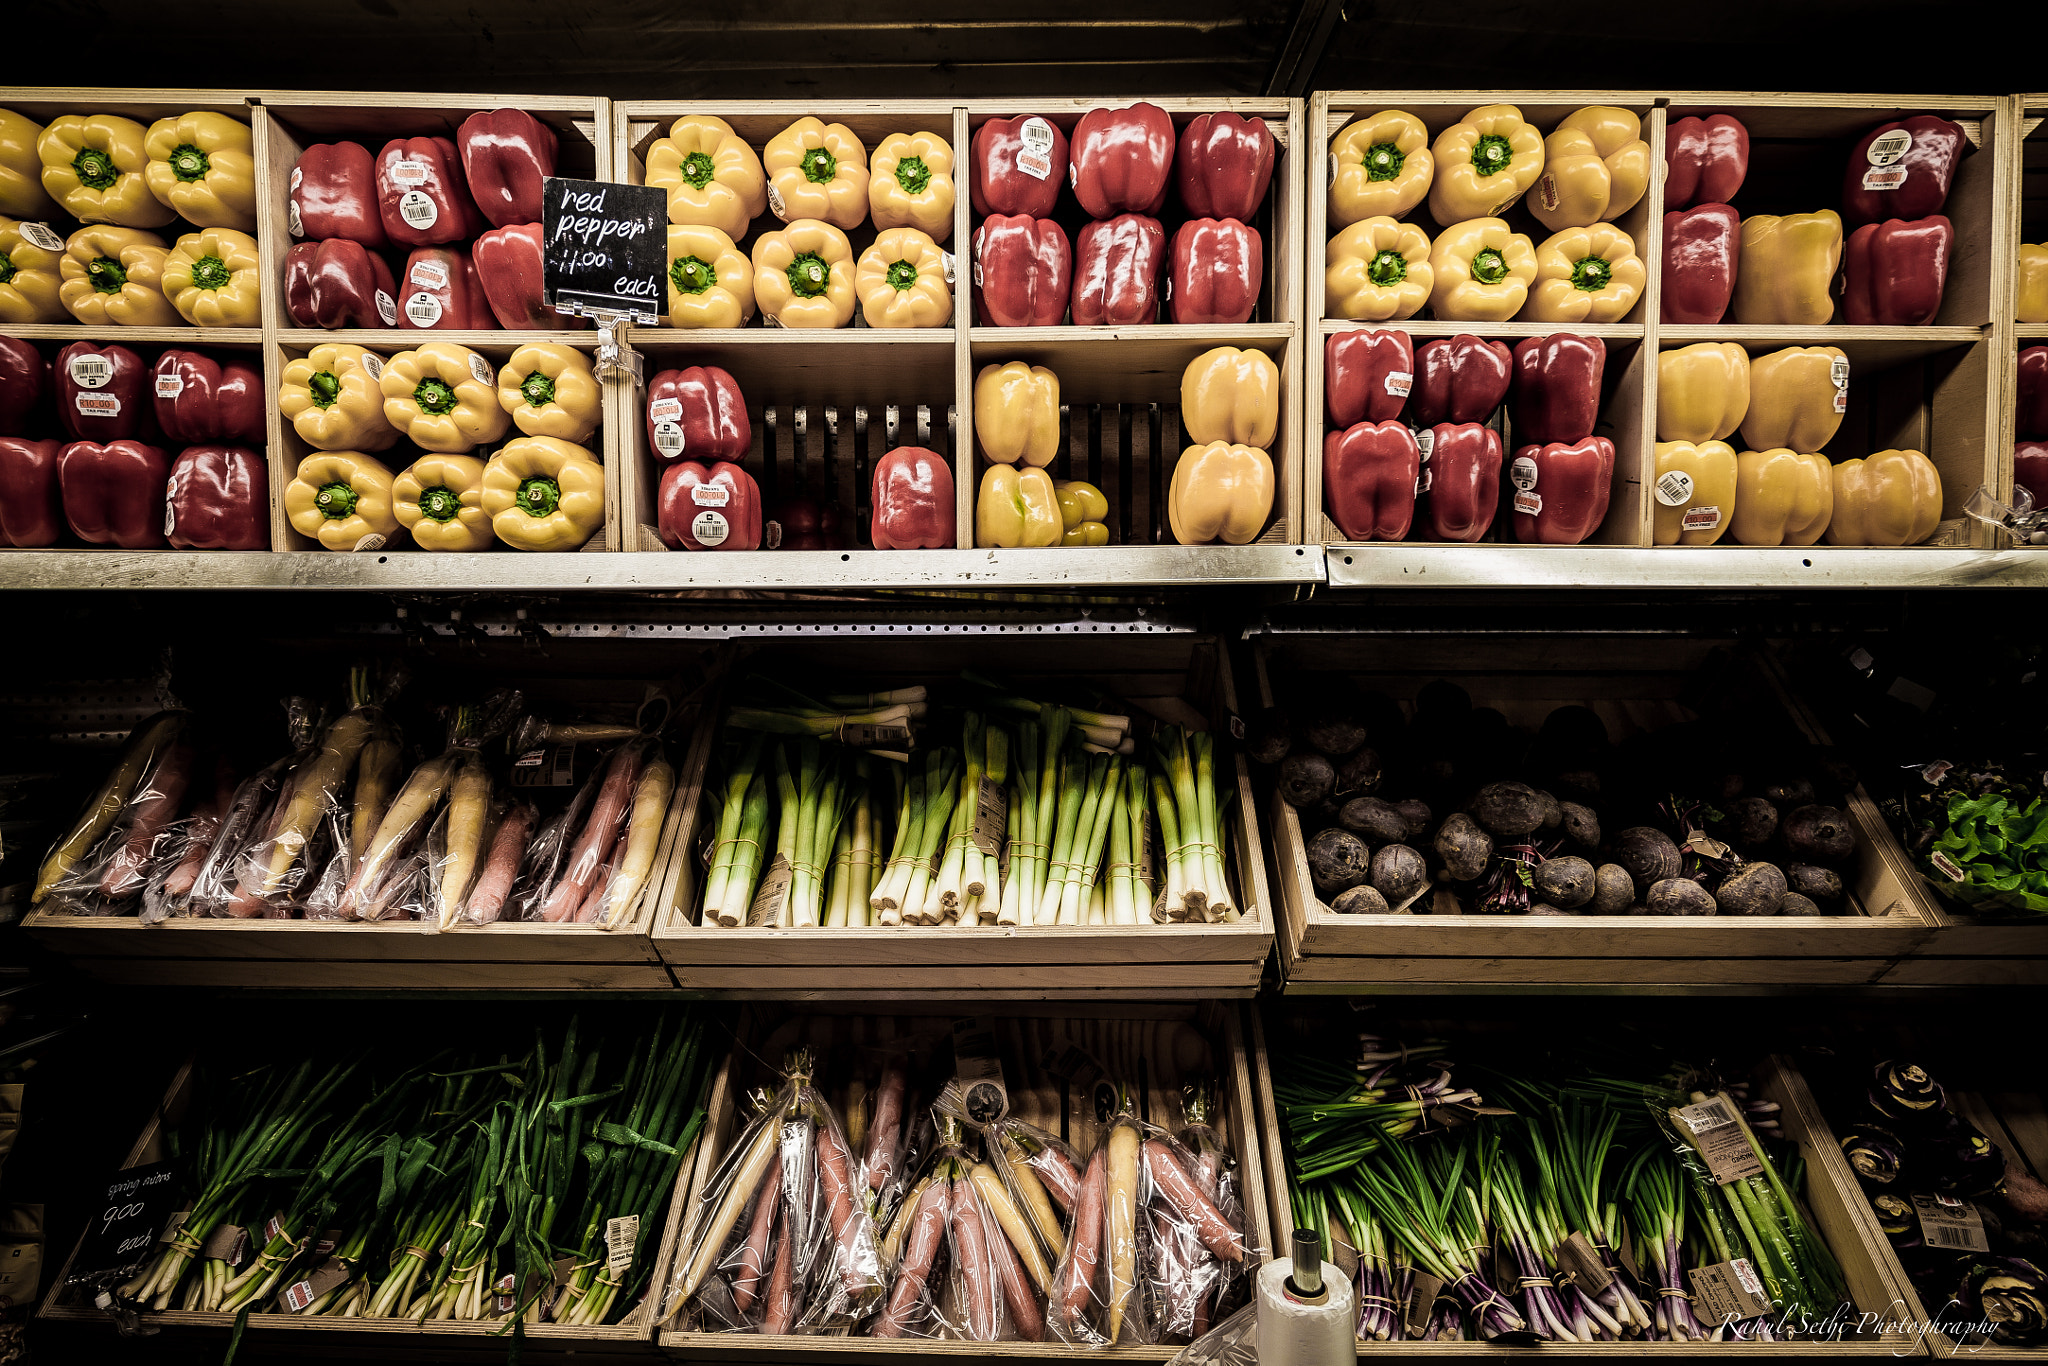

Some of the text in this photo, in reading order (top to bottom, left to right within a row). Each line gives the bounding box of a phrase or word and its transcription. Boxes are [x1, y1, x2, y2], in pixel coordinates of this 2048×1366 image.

[560, 188, 606, 213] red
[554, 214, 646, 246] pepper
[614, 275, 660, 298] each
[80, 399, 111, 408] R10.00
[1732, 1151, 1755, 1163] WASHED
[108, 1178, 140, 1200] spring
[101, 1202, 145, 1235] 9.00
[117, 1227, 153, 1254] each
[1698, 1275, 1714, 1300] ONIONS
